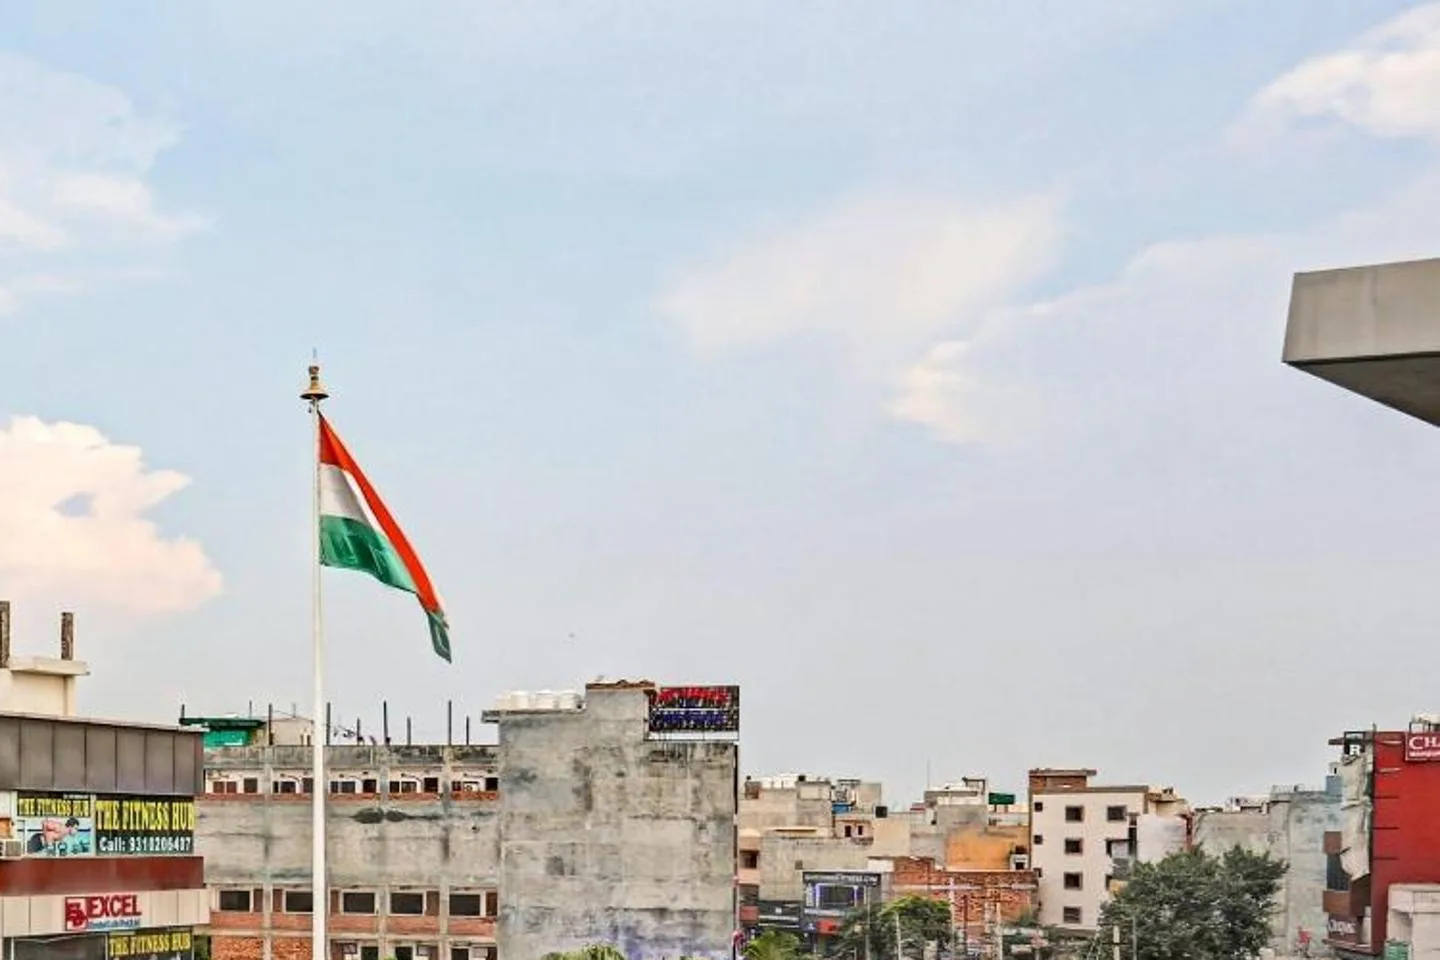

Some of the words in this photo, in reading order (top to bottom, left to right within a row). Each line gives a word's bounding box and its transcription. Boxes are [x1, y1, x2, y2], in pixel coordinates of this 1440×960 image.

[1409, 736, 1440, 750] CH
[96, 800, 120, 830] THE
[122, 801, 169, 830] FITNESS
[172, 802, 195, 830] HUB
[100, 836, 126, 852] Call:
[86, 895, 142, 918] EXCEL
